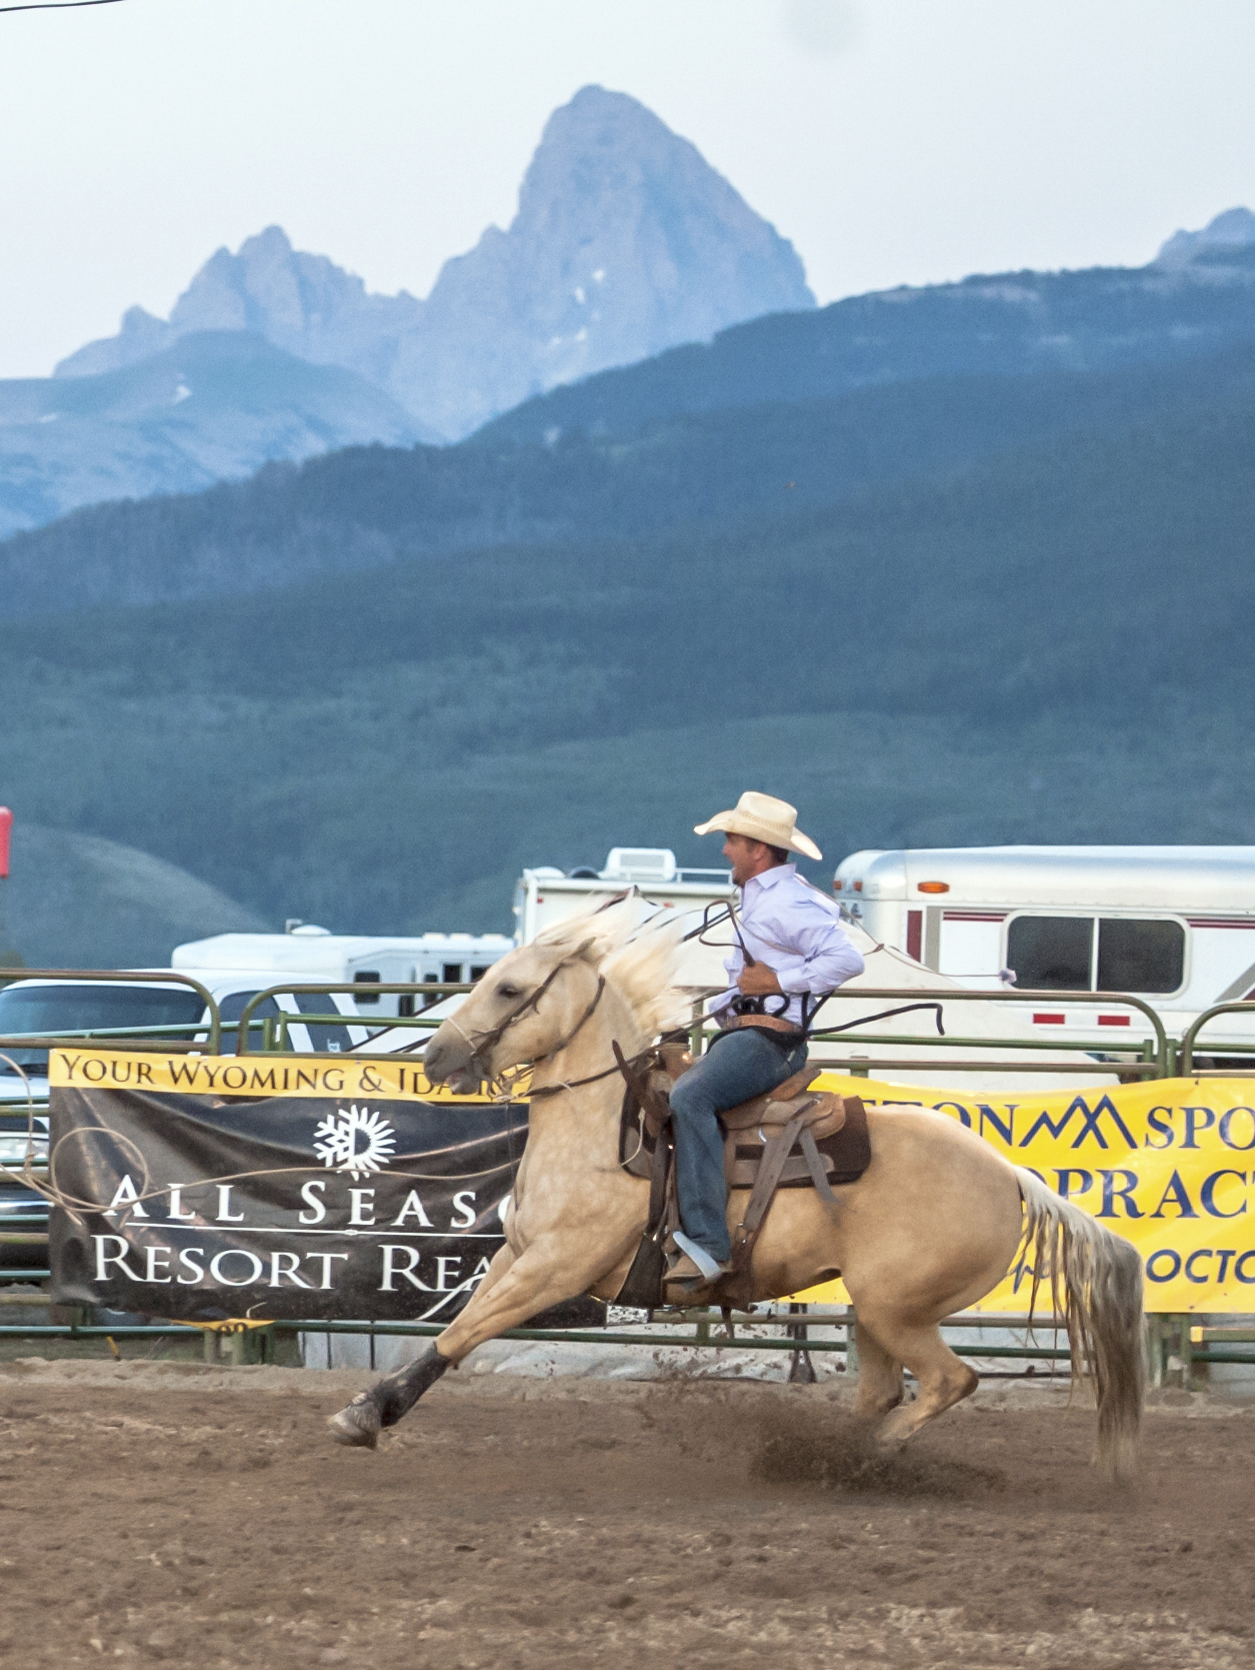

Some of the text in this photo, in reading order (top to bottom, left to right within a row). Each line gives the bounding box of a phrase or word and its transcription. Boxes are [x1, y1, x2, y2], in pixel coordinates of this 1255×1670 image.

[60, 1054, 157, 1085] YOUR
[167, 1060, 345, 1092] WYOMING
[358, 1066, 386, 1093] &
[102, 1174, 511, 1228] ALL SEAS
[90, 1234, 349, 1290] RESORT
